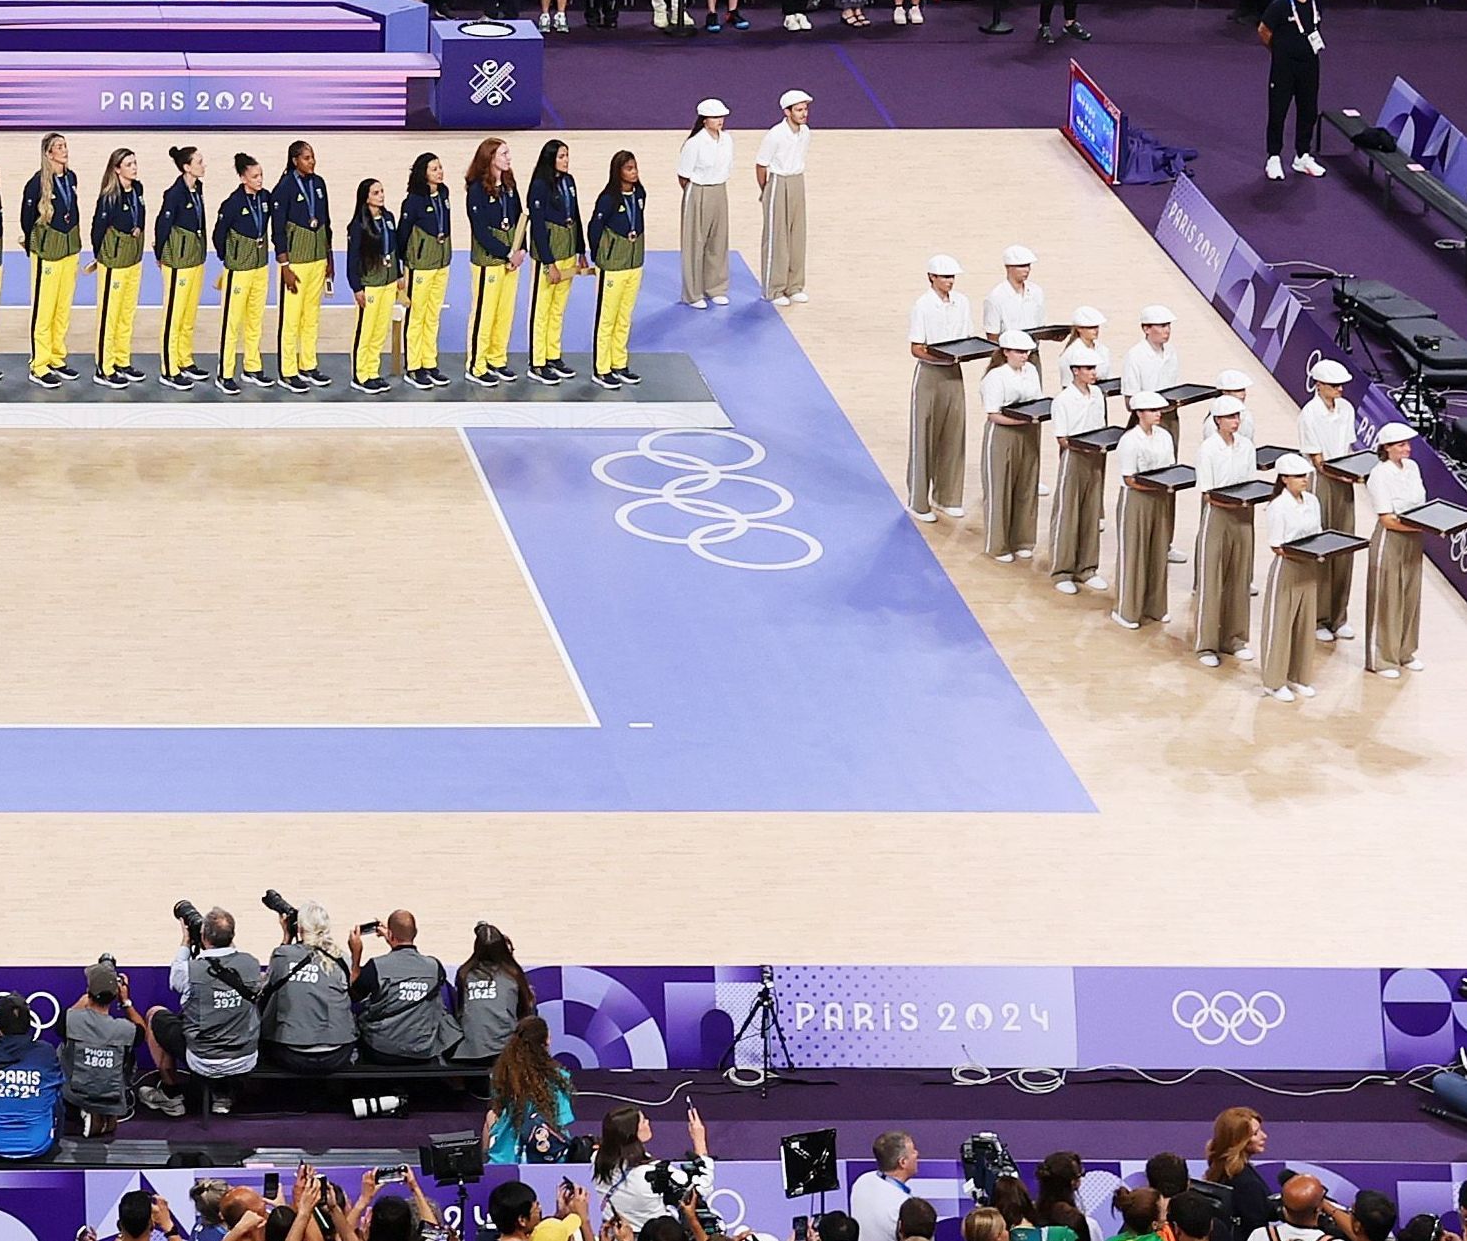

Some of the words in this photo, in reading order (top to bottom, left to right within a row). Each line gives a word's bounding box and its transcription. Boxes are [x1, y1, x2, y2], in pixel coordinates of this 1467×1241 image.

[100, 91, 185, 111] PARIS
[195, 91, 273, 111] 2024
[1166, 200, 1197, 244] PARIS
[1192, 230, 1221, 276] 2024
[288, 962, 319, 973] POTO
[399, 982, 428, 992] PHOTO
[467, 987, 497, 1000] 1625
[213, 996, 243, 1009] 3927
[795, 1001, 919, 1032] PARIS
[936, 1001, 1050, 1032] 2024
[85, 1048, 114, 1058] PHOTO
[84, 1056, 114, 1068] 1808
